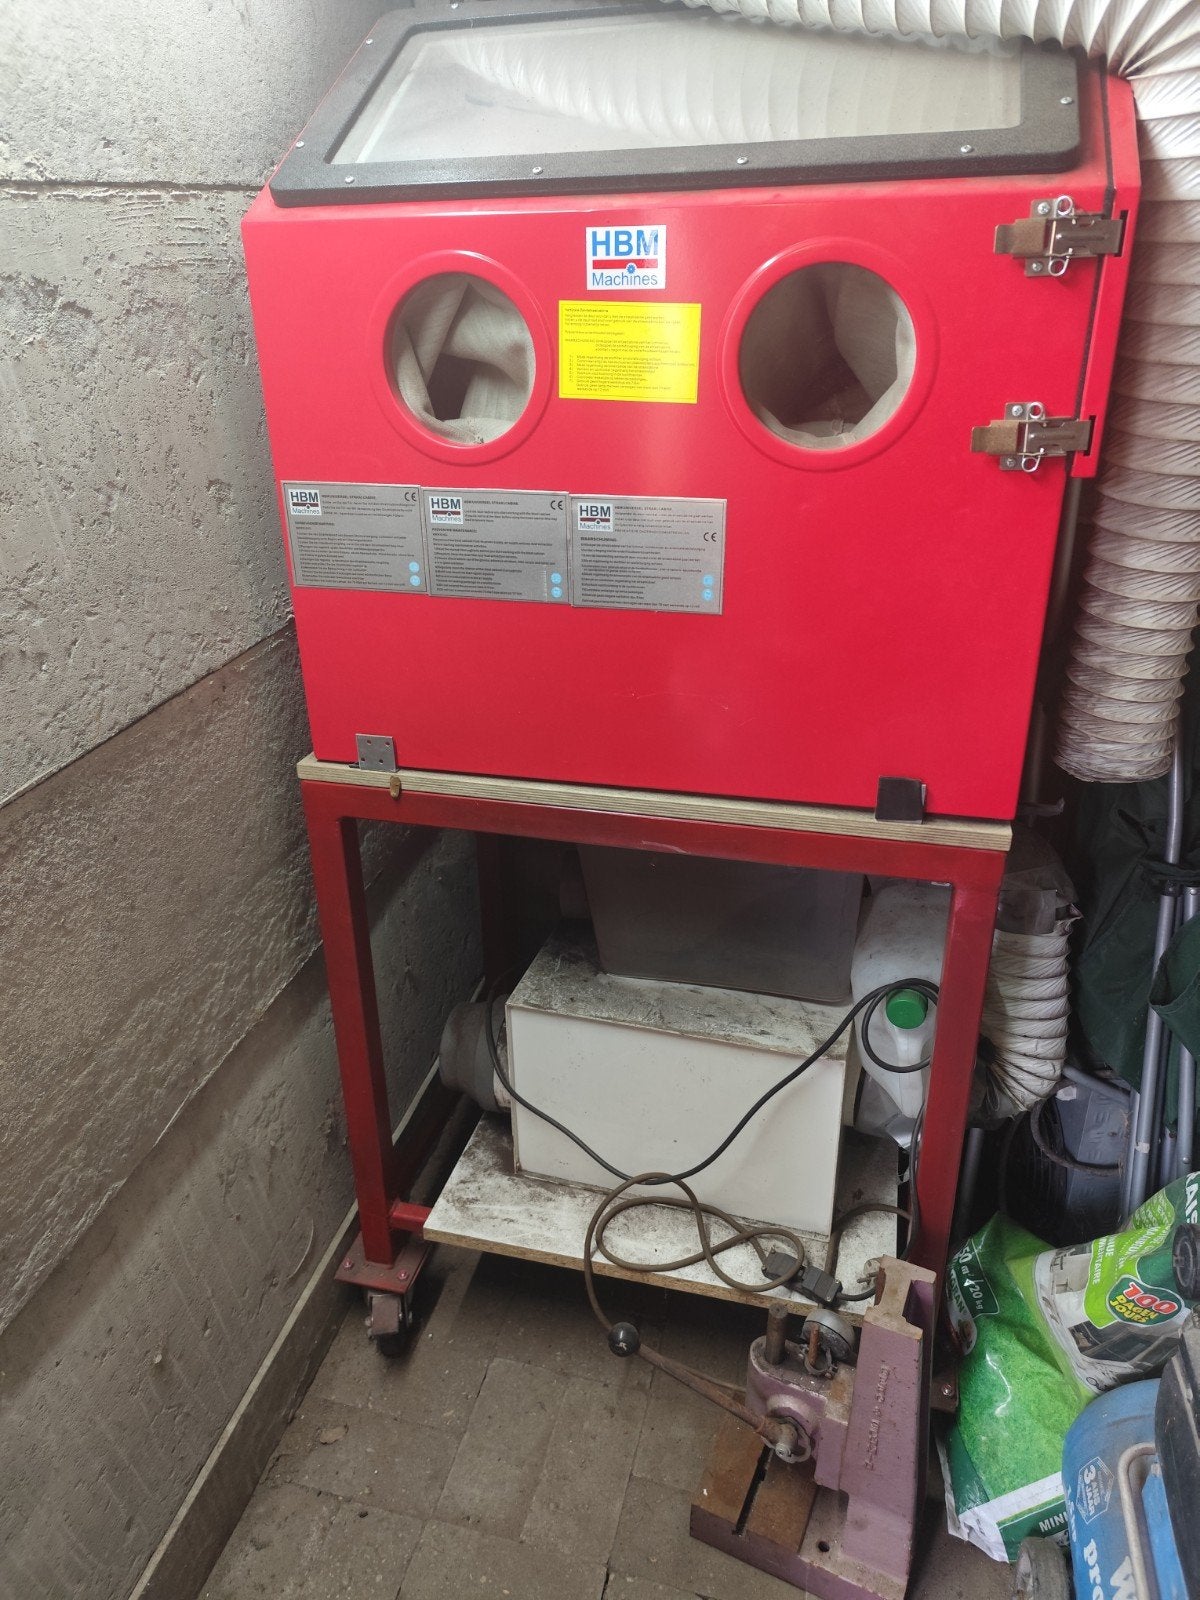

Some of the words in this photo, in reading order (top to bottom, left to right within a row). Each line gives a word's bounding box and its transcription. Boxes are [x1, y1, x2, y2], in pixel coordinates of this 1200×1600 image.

[591, 229, 659, 257] HBM
[592, 271, 658, 286] Machines
[290, 491, 319, 503] HBM
[431, 497, 462, 510] HBM
[291, 507, 321, 516] Machines
[579, 505, 611, 517] HBM
[431, 514, 462, 523] Machines
[579, 522, 611, 530] Machines
[970, 1286, 983, 1299] 20
[1123, 1281, 1178, 1315] 100
[1109, 1300, 1149, 1323] JOURS
[1116, 1294, 1159, 1320] DAGEN
[1083, 1464, 1096, 1485] 3
